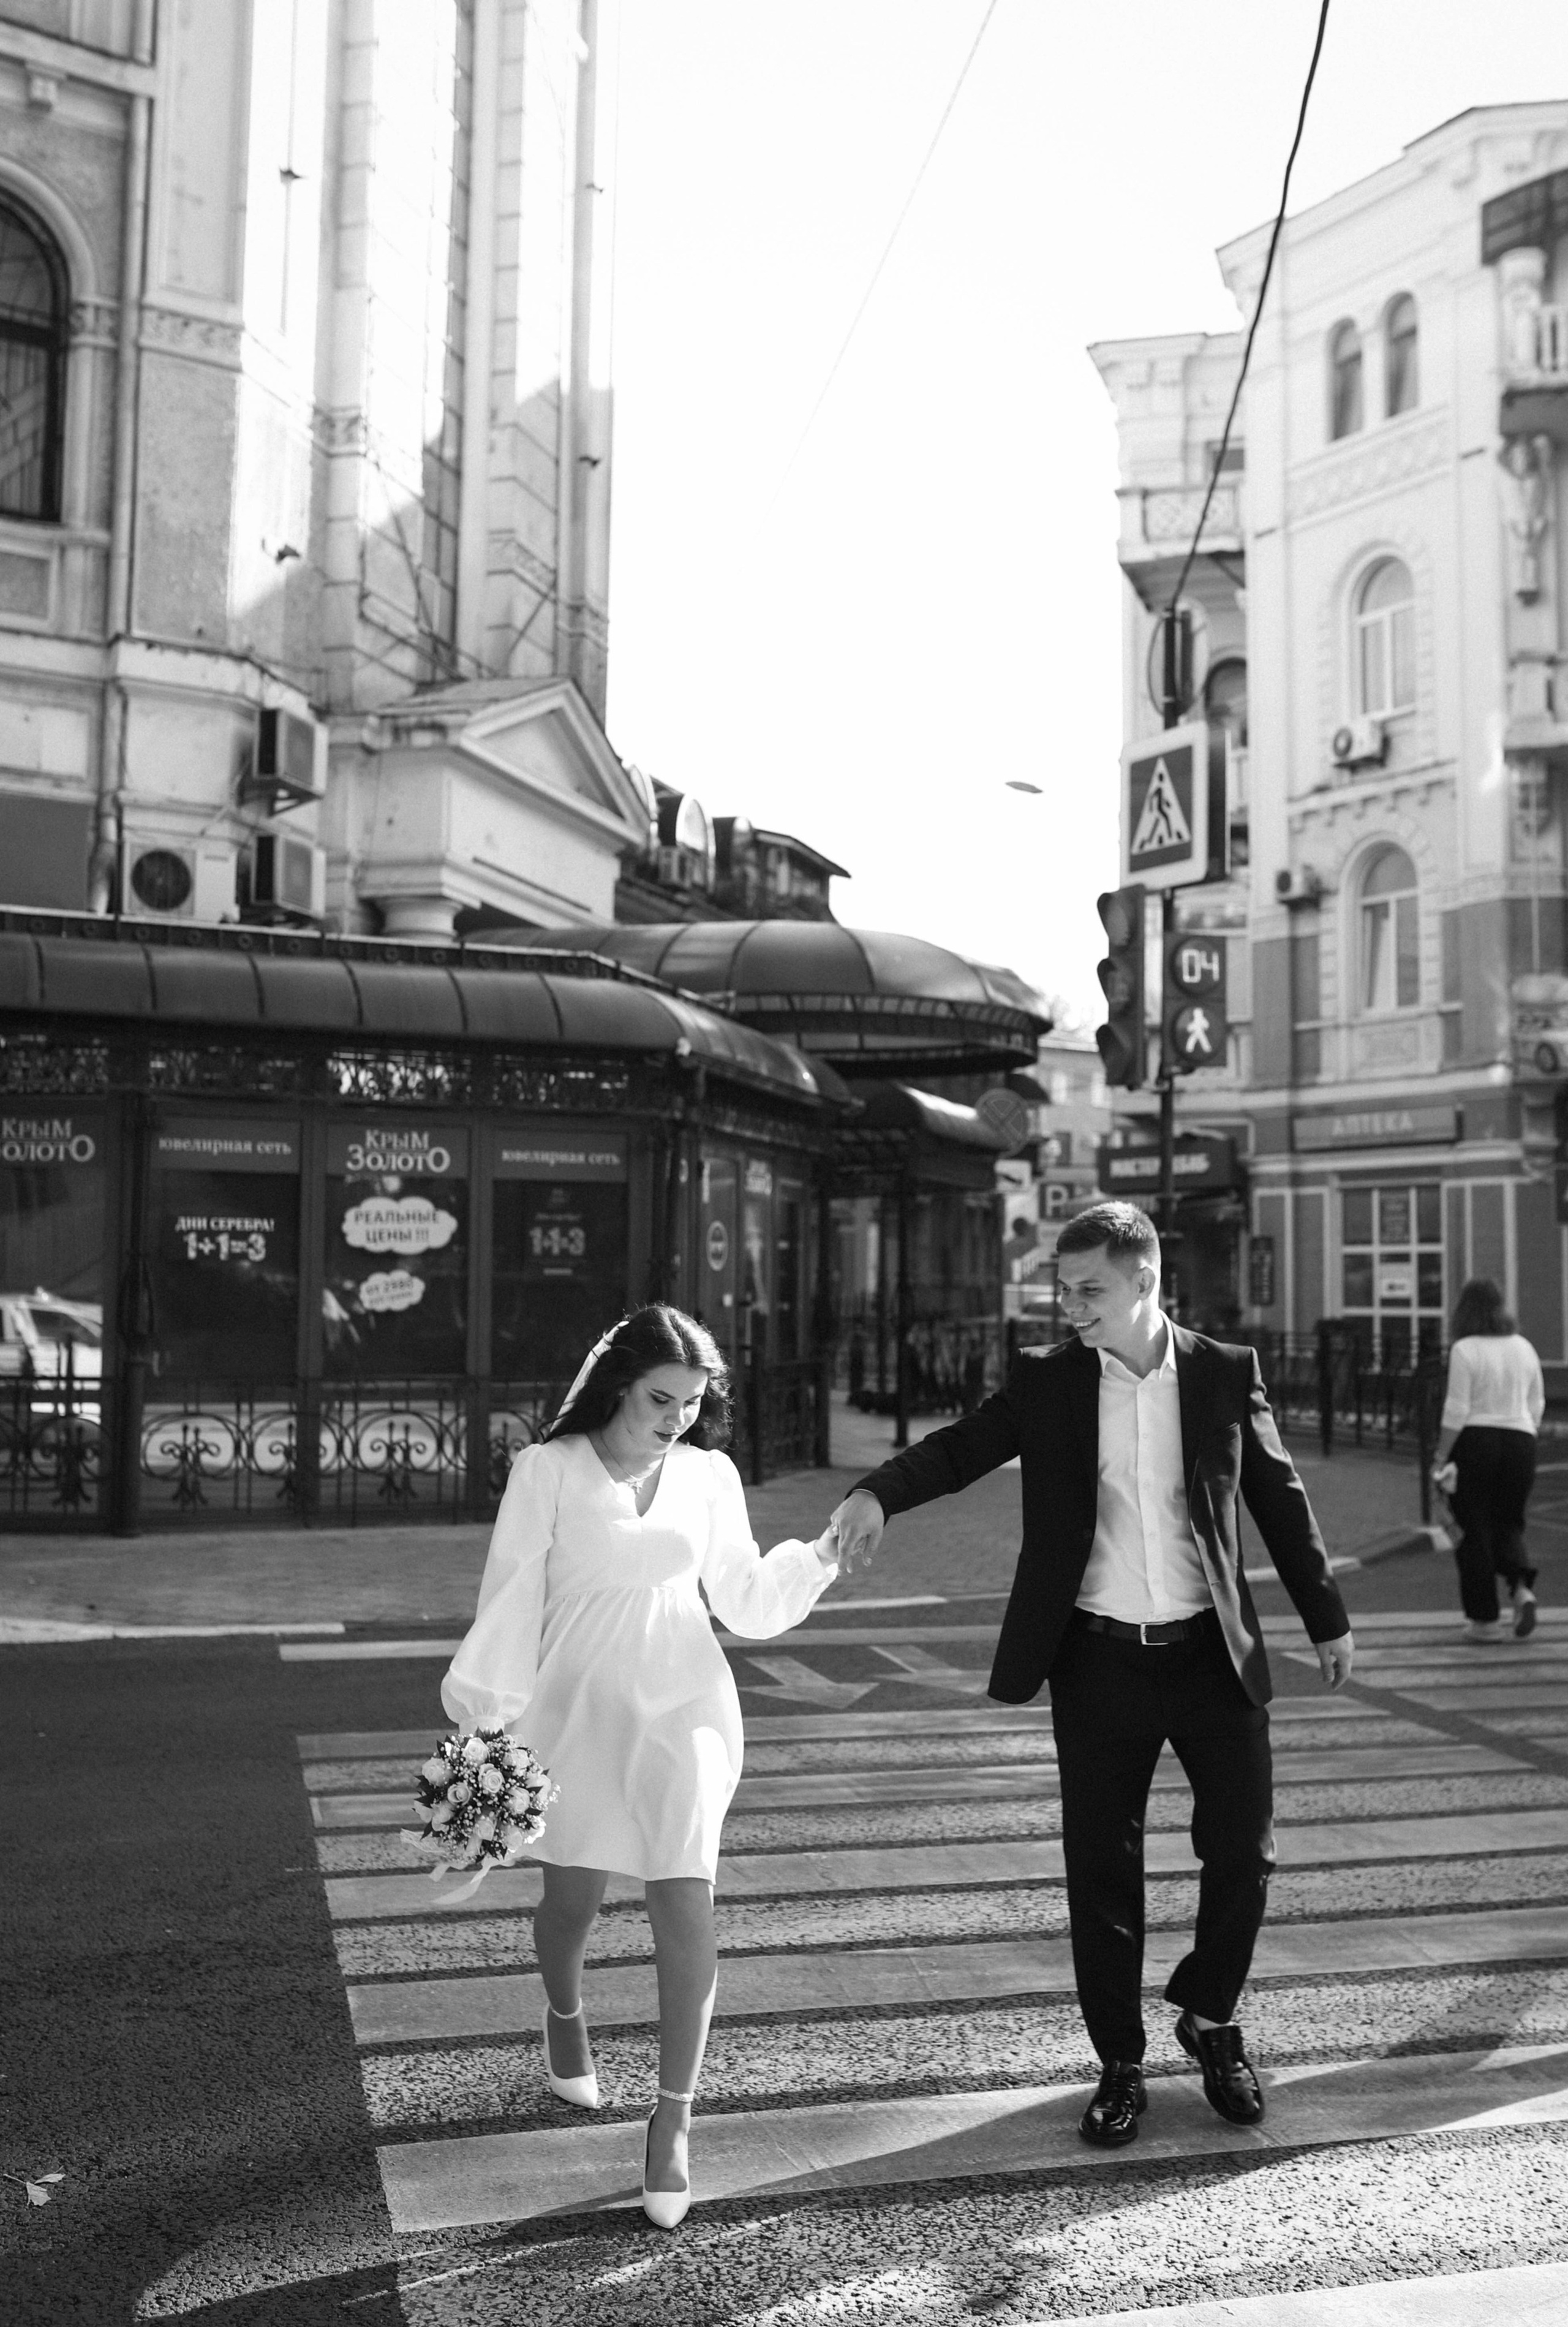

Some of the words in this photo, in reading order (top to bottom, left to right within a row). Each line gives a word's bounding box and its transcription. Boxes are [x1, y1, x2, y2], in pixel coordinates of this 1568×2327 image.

[1182, 949, 1219, 983] 04
[2, 1118, 72, 1138] КРЫМ
[1, 1134, 96, 1162] ОЛОТО
[257, 1141, 292, 1155] сеть
[366, 1130, 429, 1149] КРЫМ
